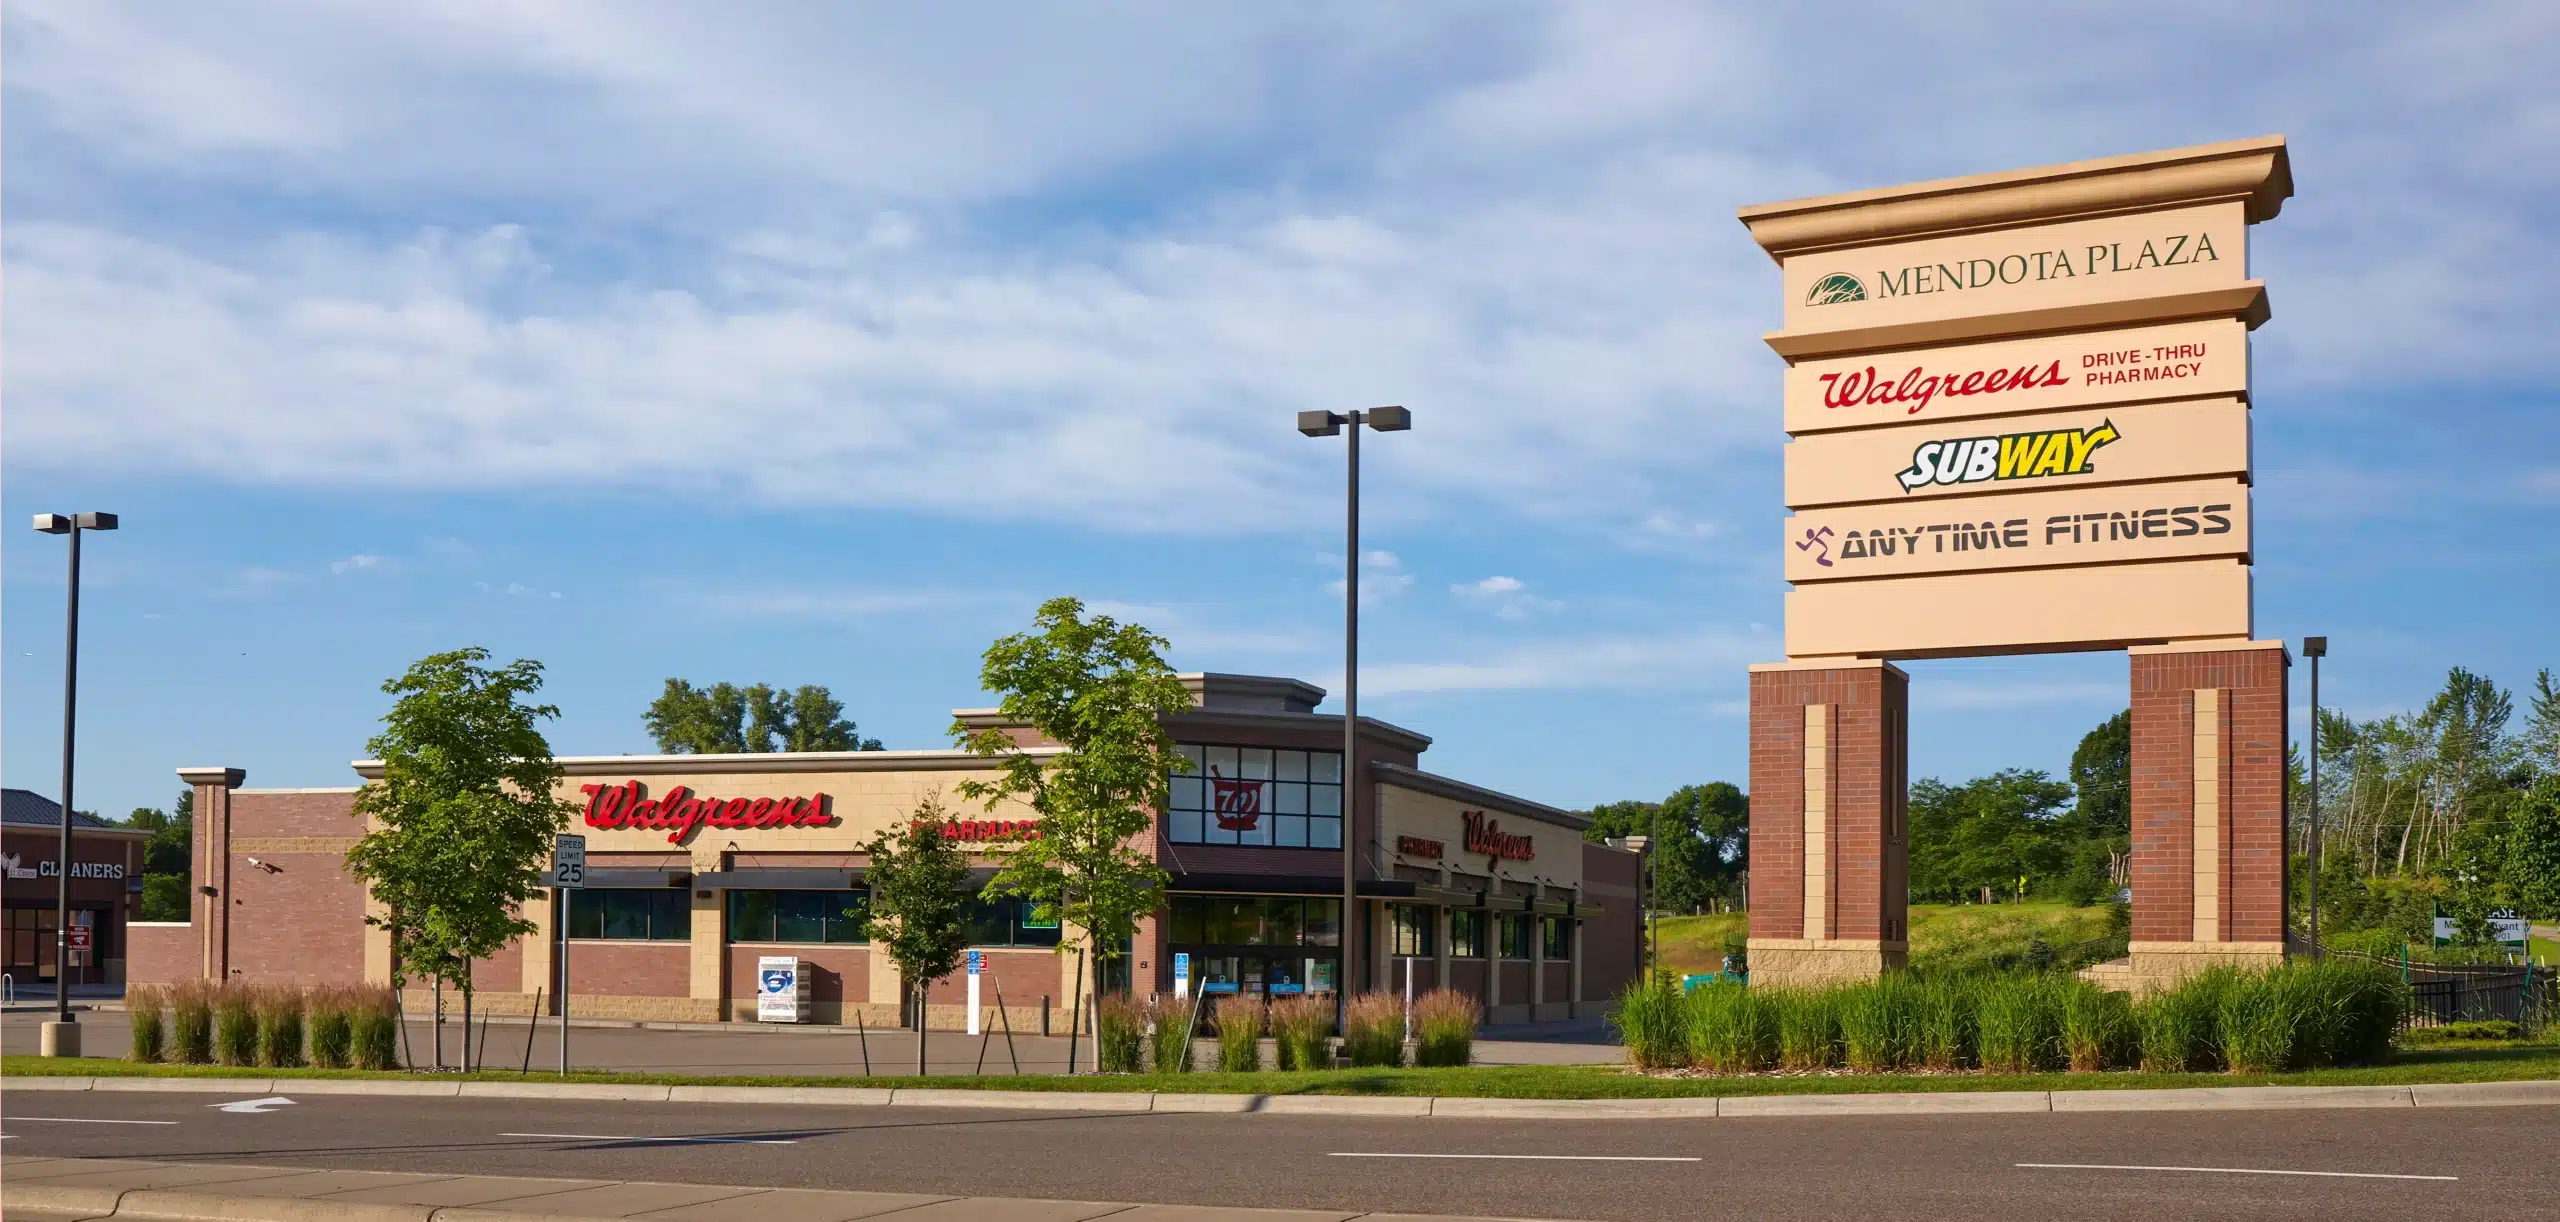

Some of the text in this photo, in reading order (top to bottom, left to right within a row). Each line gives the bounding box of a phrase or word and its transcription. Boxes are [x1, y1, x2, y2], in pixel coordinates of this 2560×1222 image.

[1877, 232, 2219, 299] MENDOTA PLAZA
[1819, 359, 2070, 415] Walgreens
[2086, 362, 2201, 386] PHARMACY
[1899, 423, 2119, 490] SUBWAY
[1841, 504, 2232, 559] ANYTIME FITNESS
[580, 779, 834, 844] Walgreens
[558, 840, 583, 849] SPEED
[560, 851, 580, 861] LIMIT
[1463, 811, 1535, 872] Walgreens
[40, 860, 123, 879] CLANERS
[558, 863, 582, 883] 25
